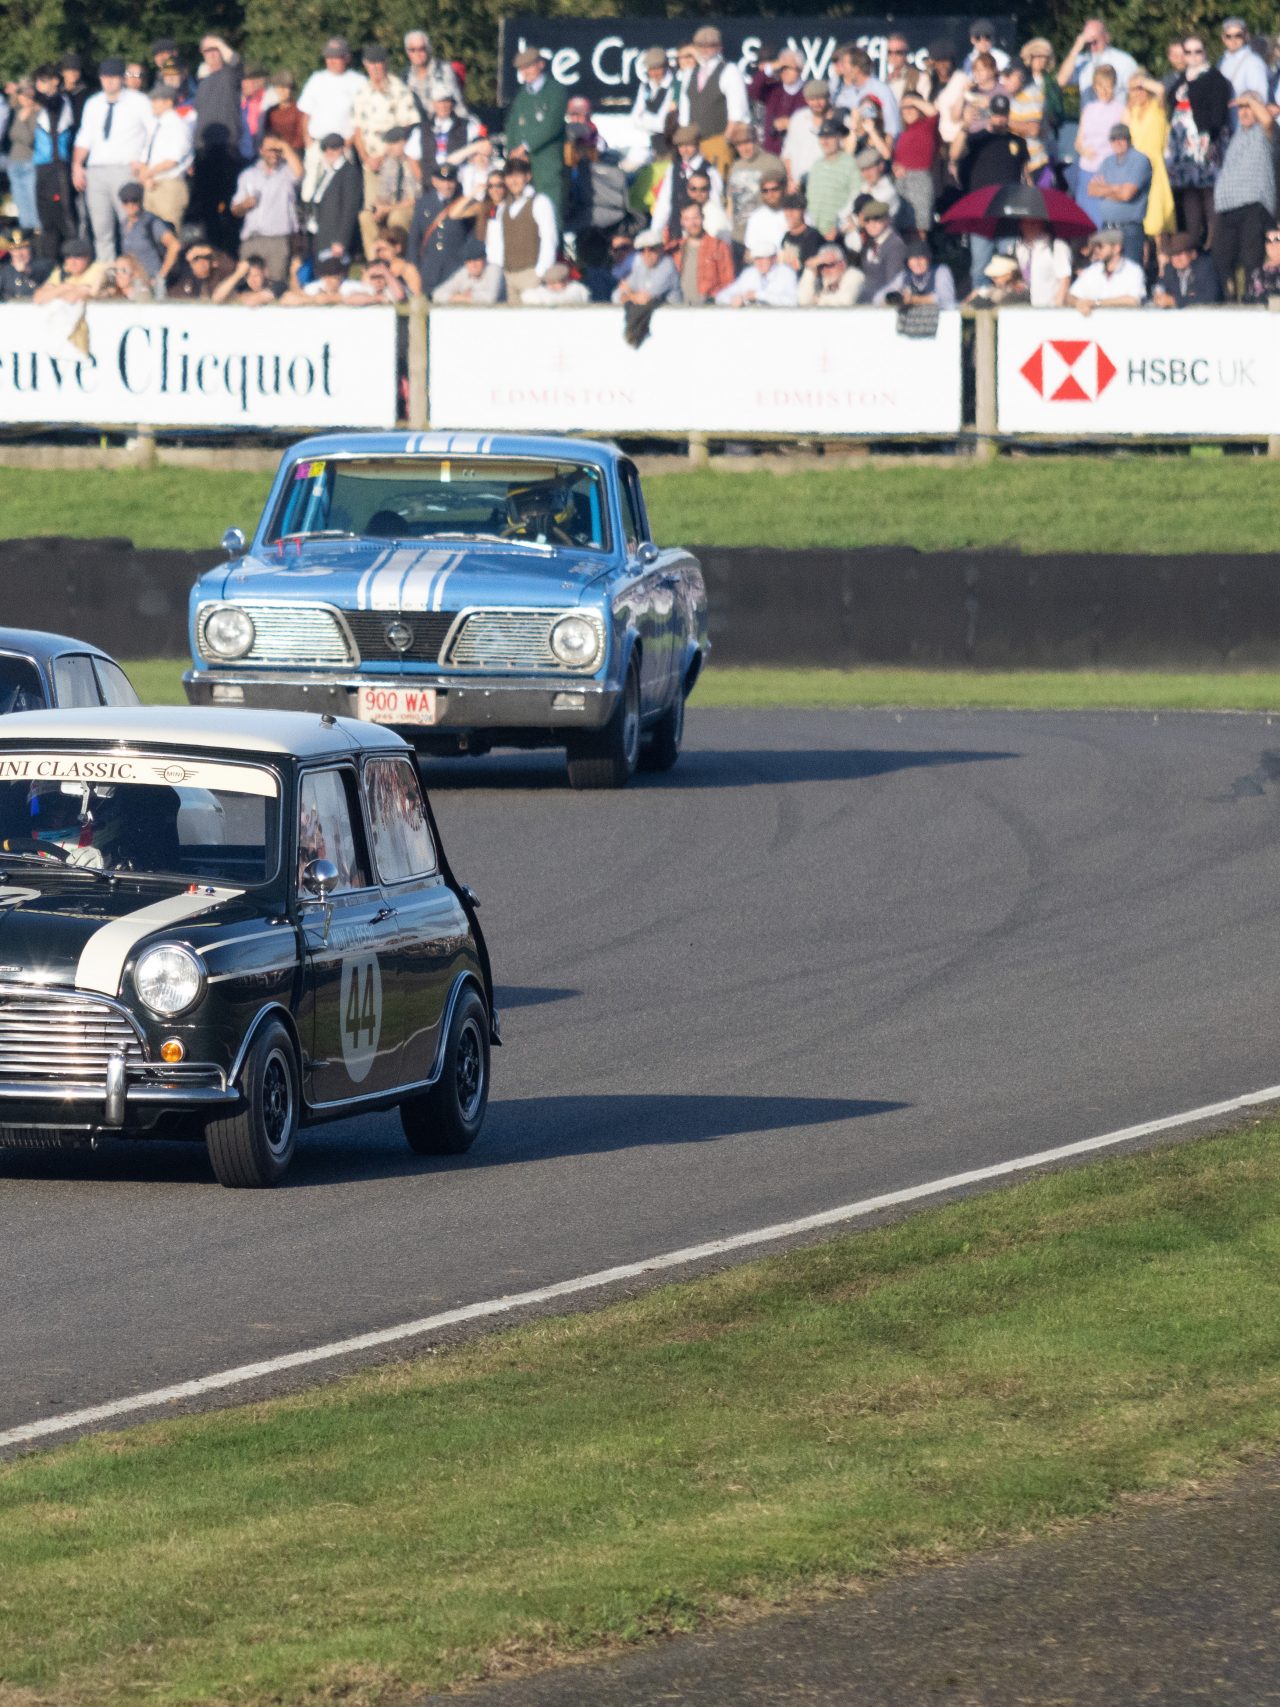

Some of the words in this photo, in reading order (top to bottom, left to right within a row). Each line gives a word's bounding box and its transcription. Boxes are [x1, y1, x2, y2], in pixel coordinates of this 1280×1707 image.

[517, 37, 581, 85] Ie
[117, 324, 334, 413] Clicquot
[1127, 357, 1210, 387] HSBC
[1217, 357, 1257, 388] UK
[489, 387, 635, 407] EDMISTON
[755, 388, 898, 409] EDMISTON
[365, 691, 398, 711] 900
[405, 692, 430, 713] WA
[166, 770, 183, 778] MINI
[345, 963, 376, 1050] 44
